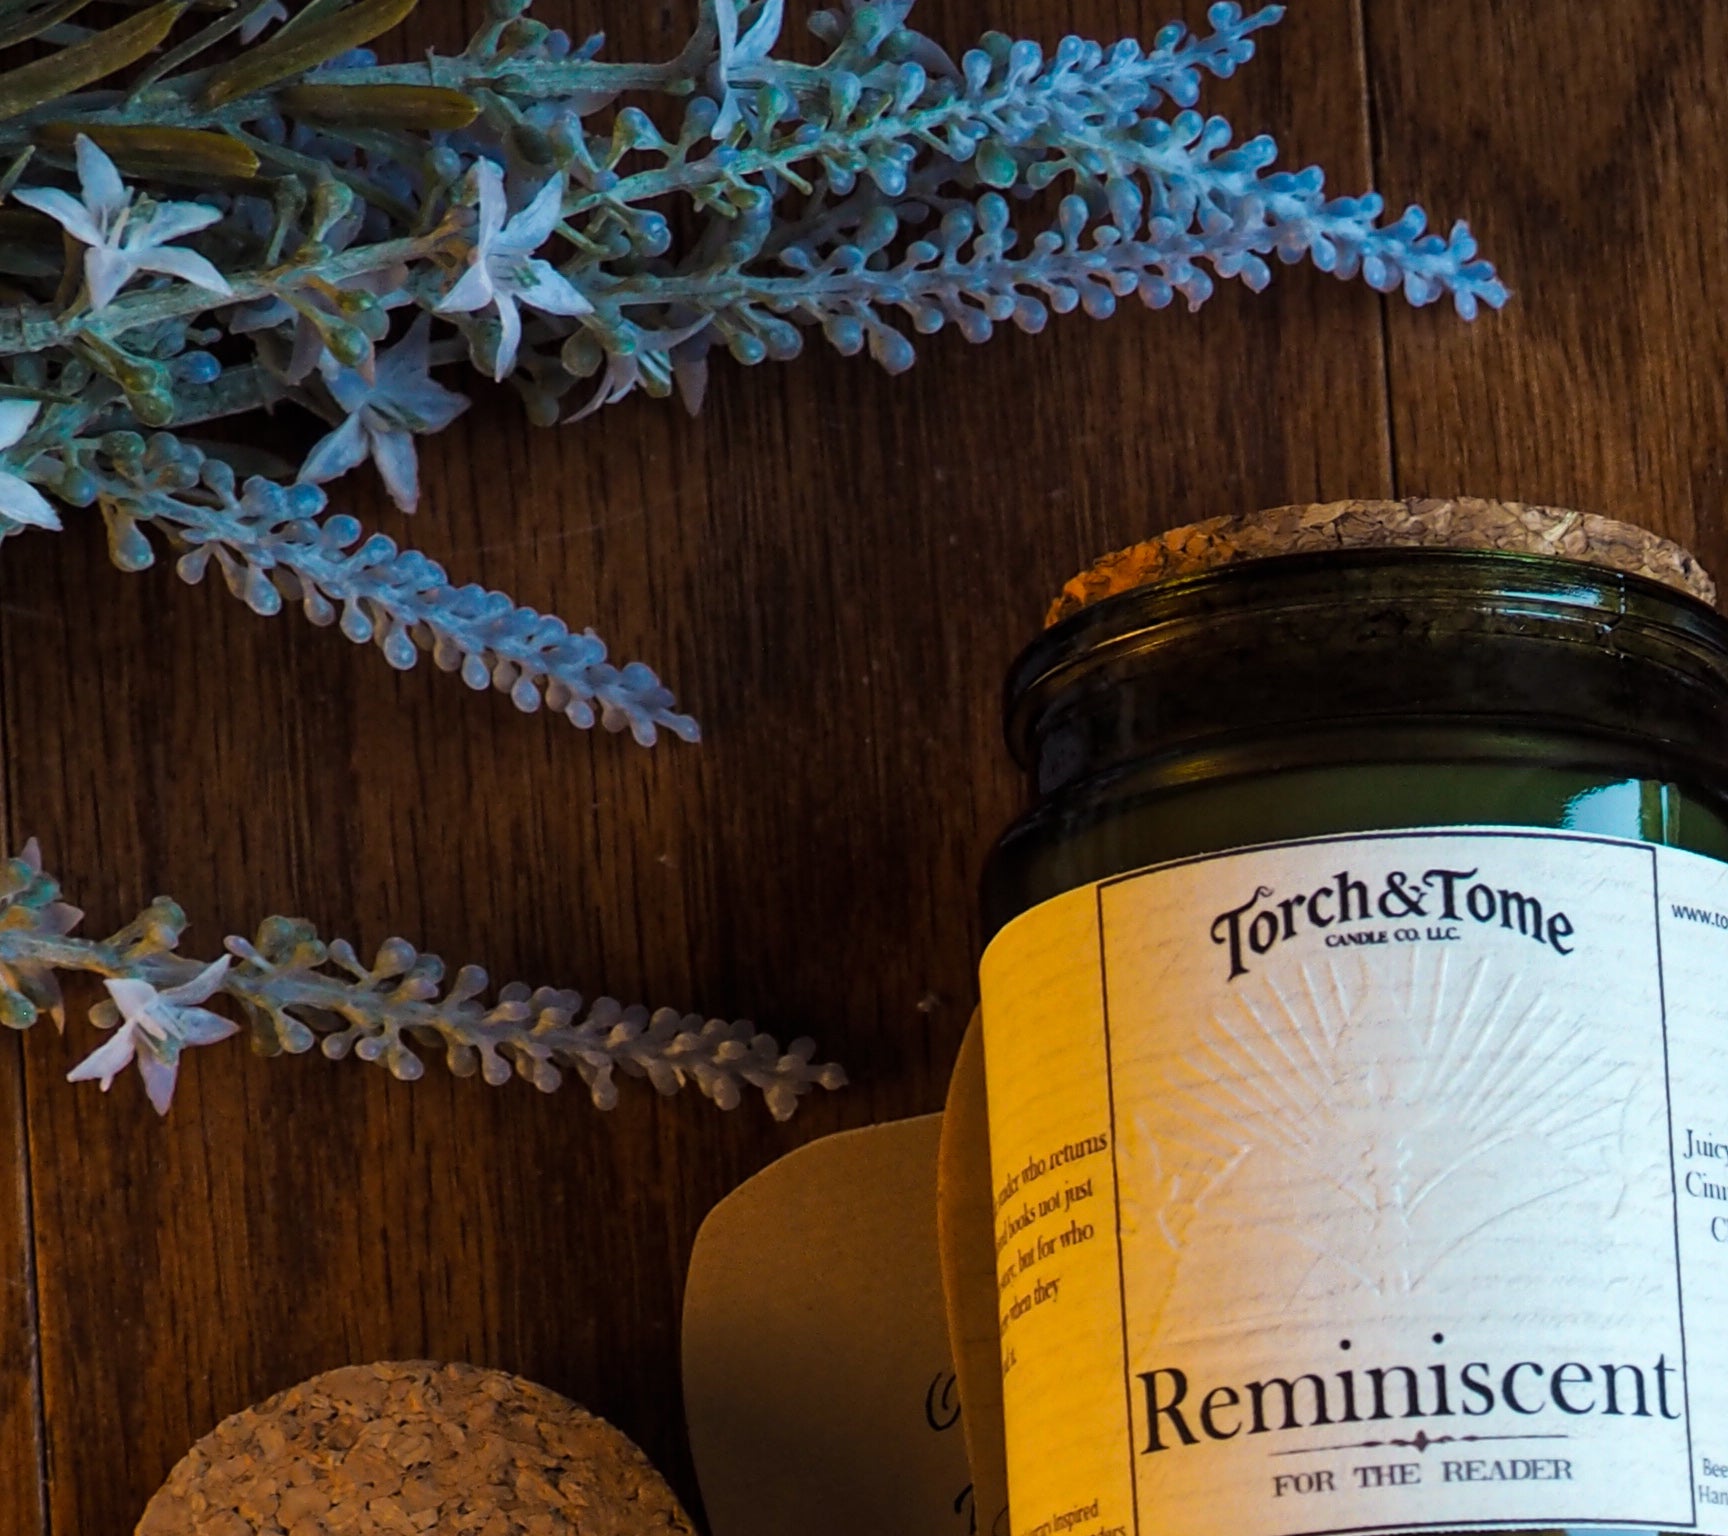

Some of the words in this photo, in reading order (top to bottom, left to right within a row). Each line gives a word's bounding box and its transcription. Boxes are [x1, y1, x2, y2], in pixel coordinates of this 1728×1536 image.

[1325, 930, 1388, 948] CANDLE
[1394, 928, 1421, 942] CO.
[1049, 1133, 1107, 1170] returns
[1064, 1178, 1093, 1213] just
[1037, 1234, 1056, 1260] for
[1059, 1219, 1094, 1248] who
[1136, 1332, 1682, 1455] Reminiscent
[1273, 1470, 1336, 1498] FOR
[1353, 1463, 1422, 1488] THE
[1442, 1458, 1574, 1483] READER
